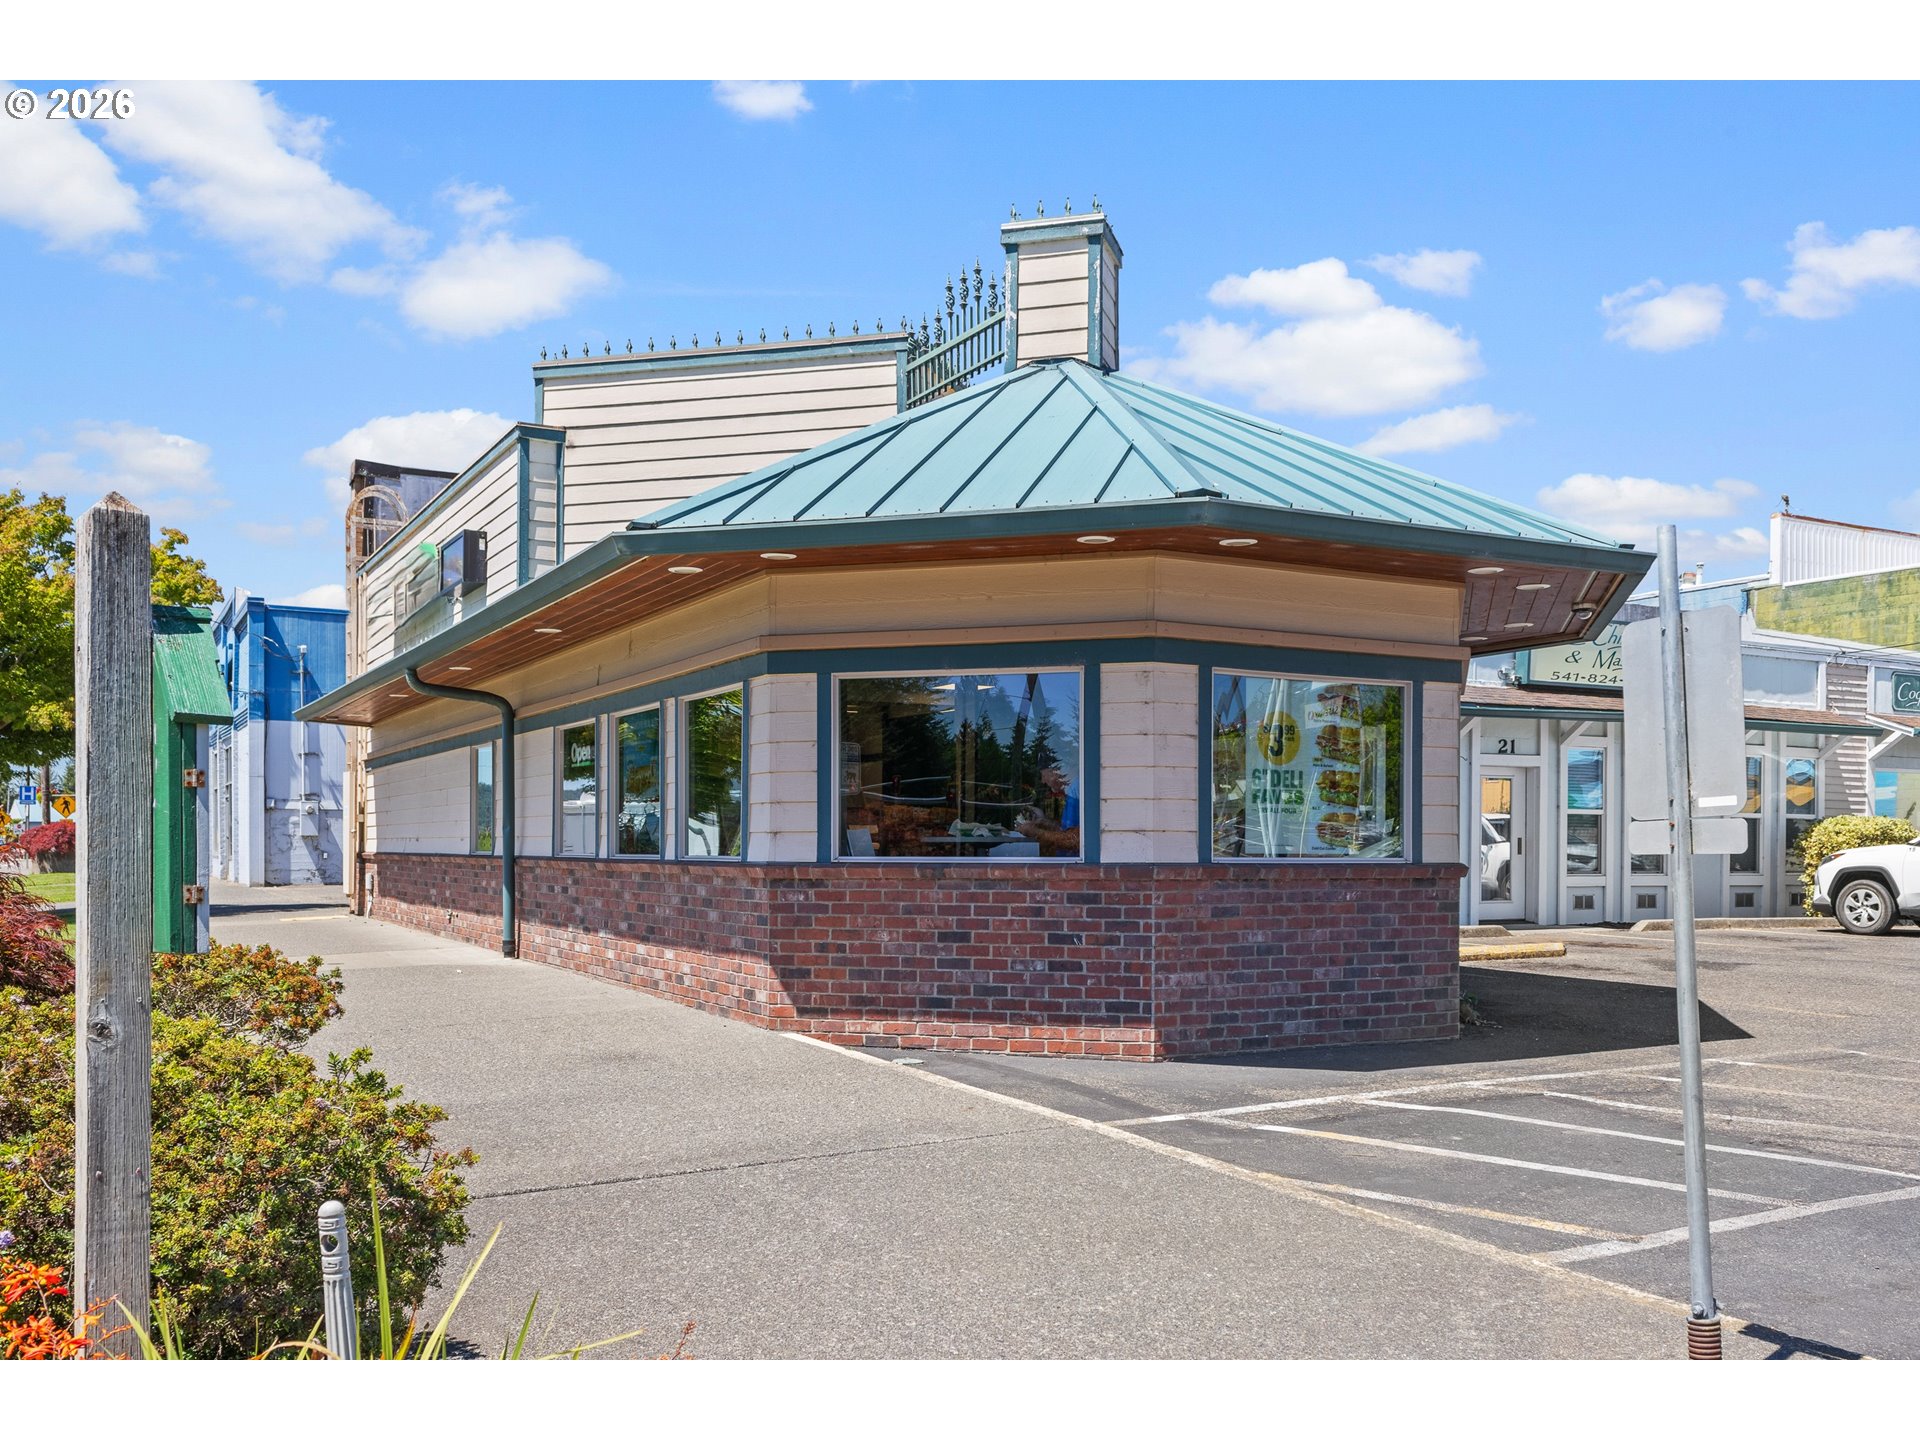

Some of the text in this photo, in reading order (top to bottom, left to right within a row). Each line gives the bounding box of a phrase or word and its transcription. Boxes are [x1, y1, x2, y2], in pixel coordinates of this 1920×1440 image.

[1564, 650, 1583, 664] &
[571, 742, 591, 766] Open
[1498, 738, 1515, 754] 21
[1270, 769, 1304, 789] DELI
[21, 786, 34, 800] H
